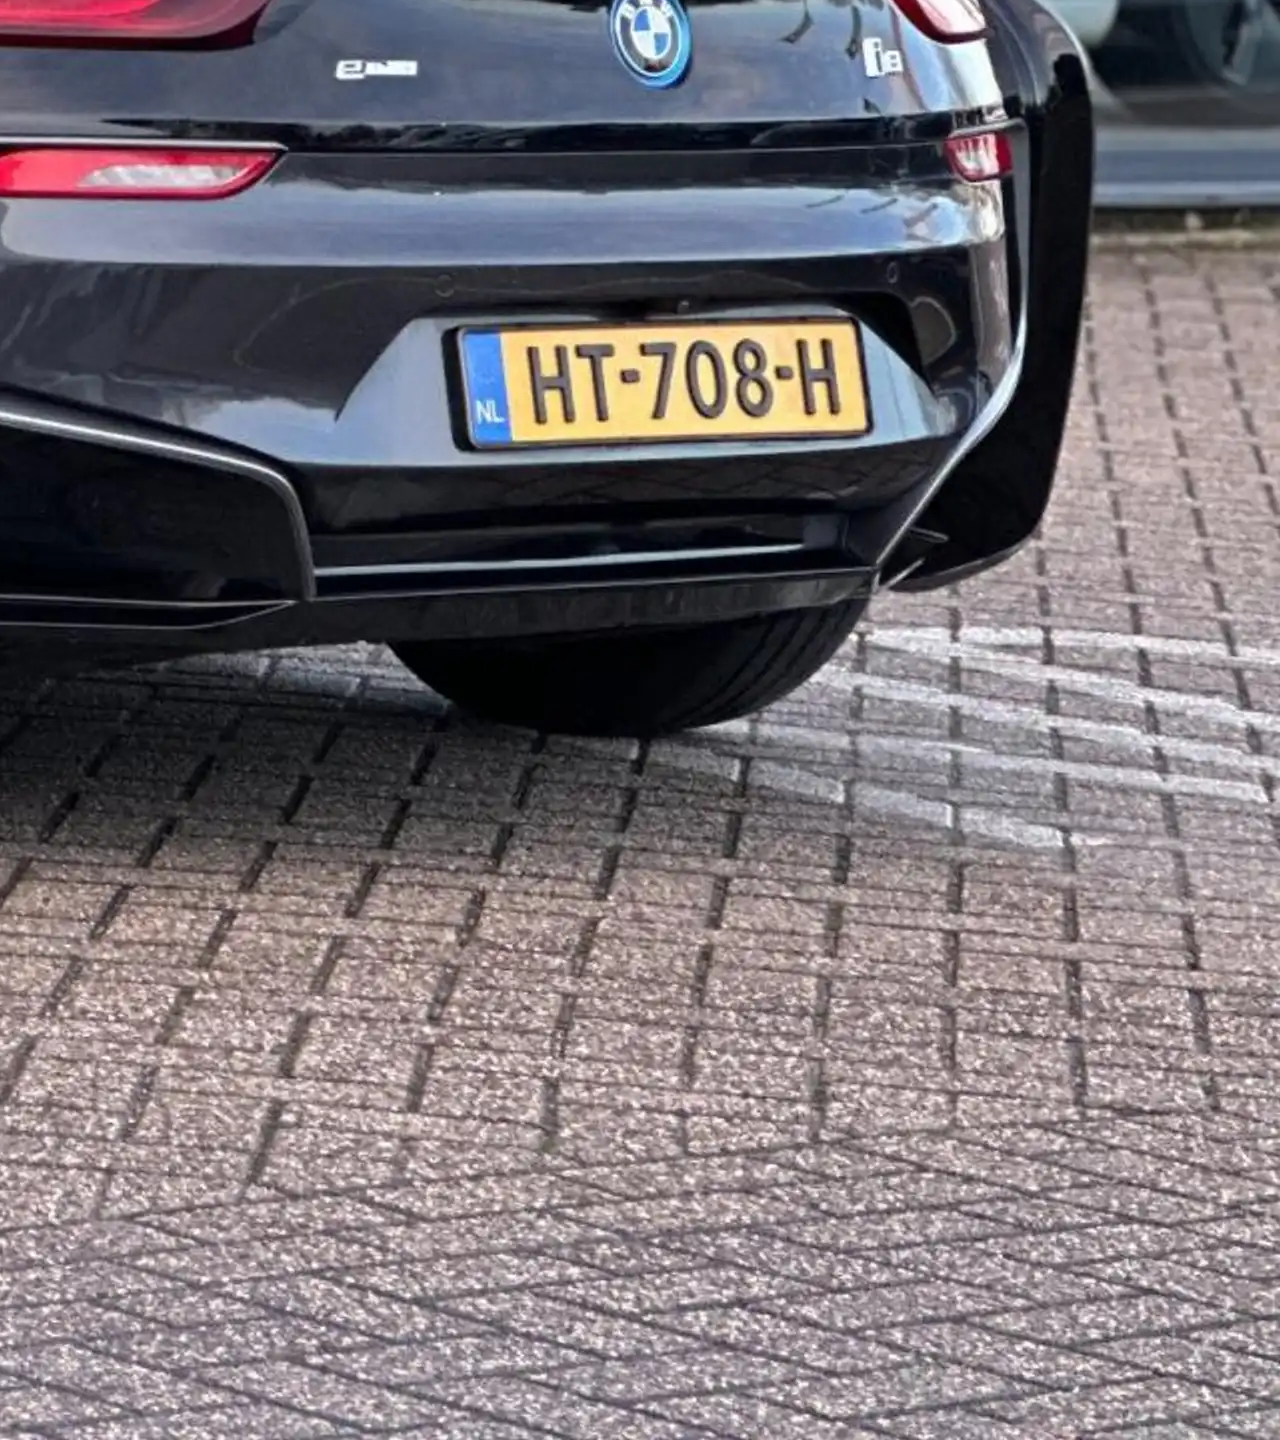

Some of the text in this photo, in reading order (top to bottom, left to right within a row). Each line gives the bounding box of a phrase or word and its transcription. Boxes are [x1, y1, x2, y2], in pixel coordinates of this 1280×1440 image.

[863, 37, 904, 77] i8
[526, 337, 842, 425] HT-708-H
[476, 400, 506, 424] NL
